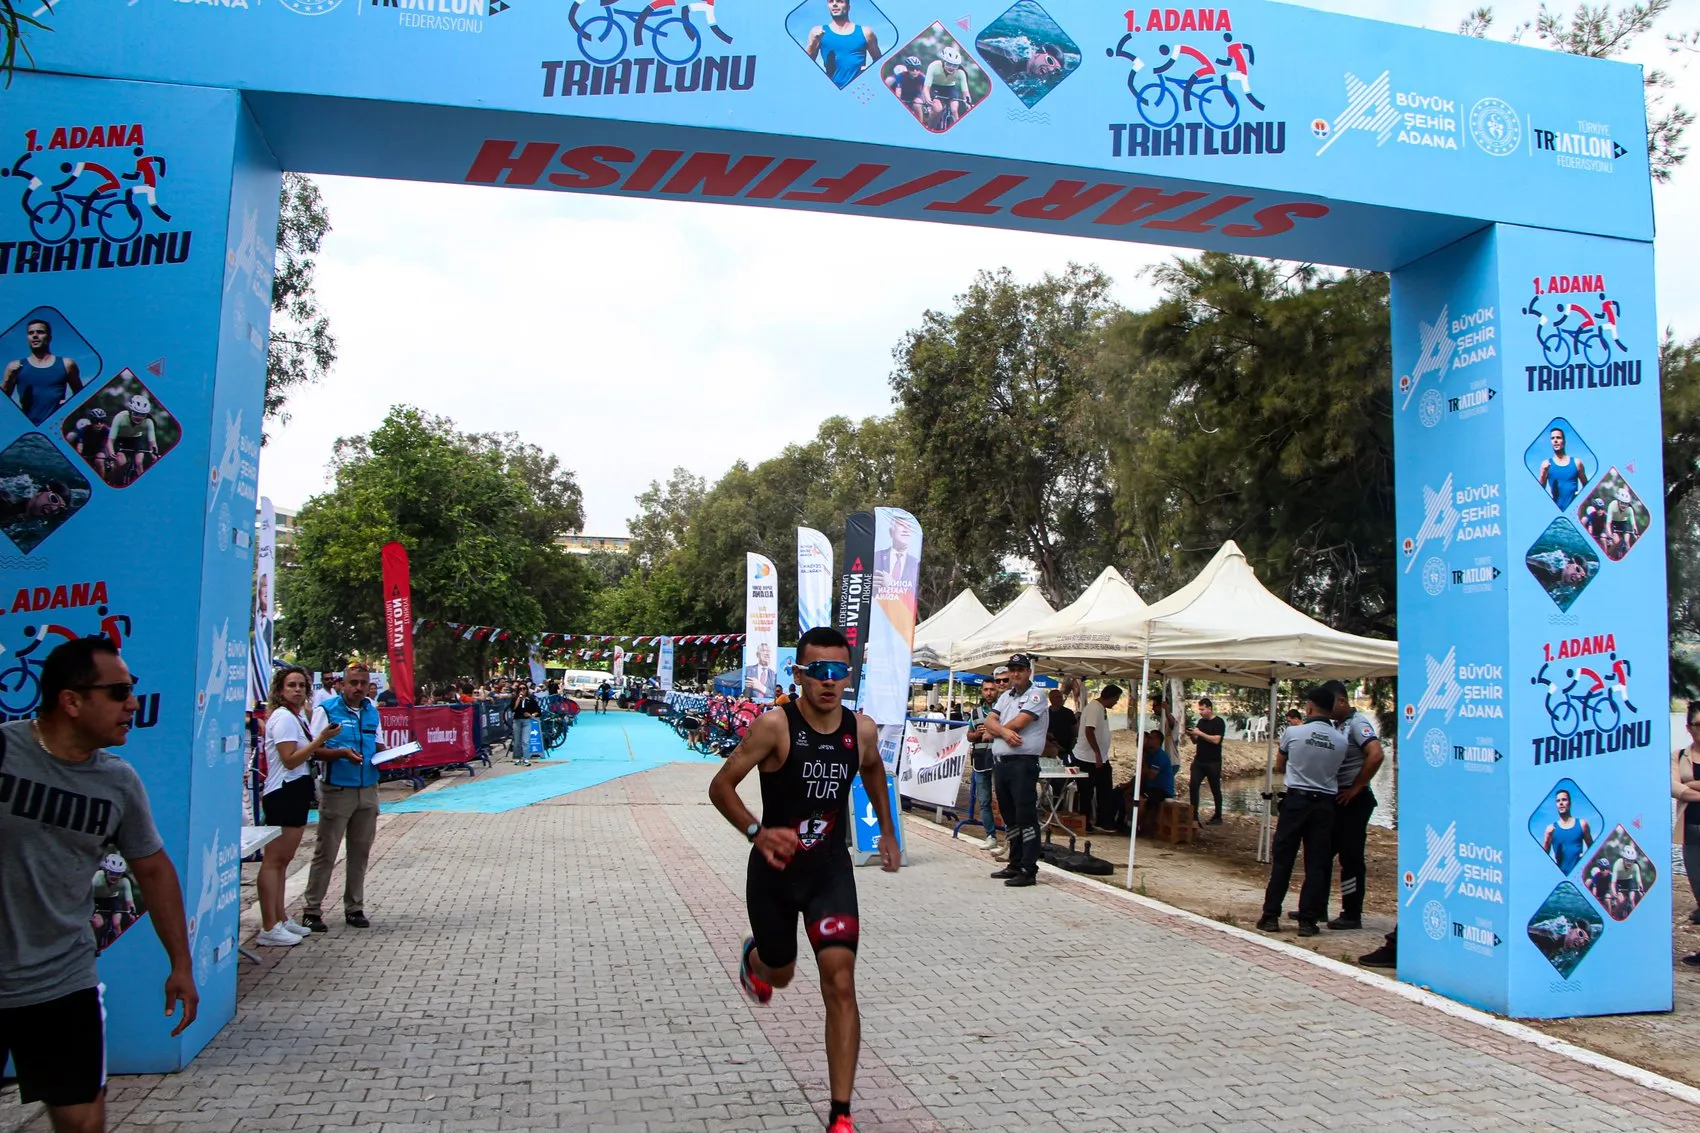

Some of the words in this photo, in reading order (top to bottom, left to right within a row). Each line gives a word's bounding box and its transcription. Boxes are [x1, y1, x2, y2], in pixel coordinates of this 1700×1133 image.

[399, 12, 483, 34] FEDERASYONU
[1146, 8, 1232, 33] ADANA
[1396, 91, 1455, 113] BÜYÜK
[1403, 112, 1456, 133] ŞEHİR
[48, 123, 145, 151] ADANA
[1396, 129, 1458, 151] ADANA
[1547, 274, 1606, 294] ADANA
[1451, 306, 1495, 335] BÜYÜK
[1456, 325, 1496, 352] ŞEHİR
[1452, 345, 1497, 371] ADANA
[1455, 483, 1499, 505] BÜYÜK
[1460, 501, 1500, 529] ŞEHİR
[1455, 522, 1501, 542] ADANA
[11, 581, 108, 614] ADANA
[1556, 633, 1617, 661] ADANA
[1458, 663, 1503, 681] BÜYÜK
[1463, 682, 1504, 705] ŞEHİR
[1457, 703, 1504, 720] ADANA
[802, 759, 848, 780] DÖLEN
[807, 780, 839, 799] TUR
[1458, 841, 1503, 865] BÜYÜK
[1463, 862, 1504, 886] ŞEHİR
[1457, 882, 1504, 905] ADANA
